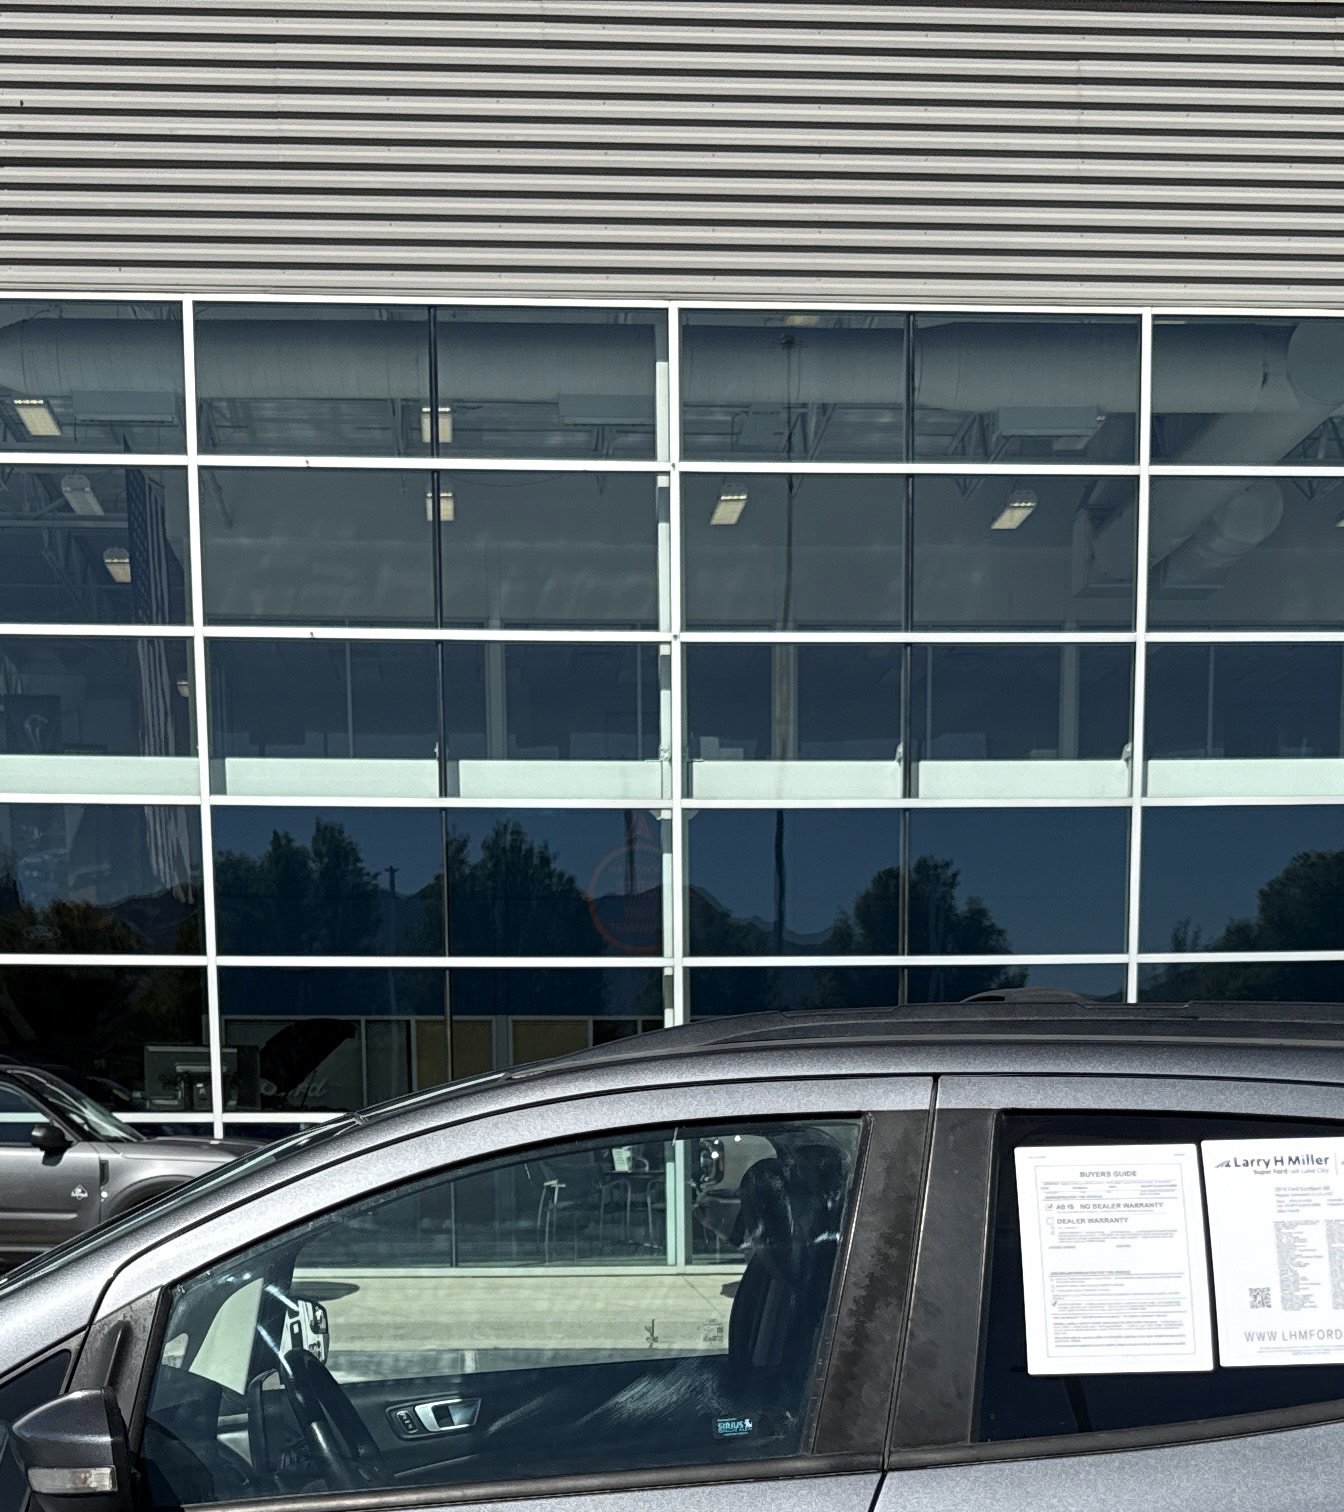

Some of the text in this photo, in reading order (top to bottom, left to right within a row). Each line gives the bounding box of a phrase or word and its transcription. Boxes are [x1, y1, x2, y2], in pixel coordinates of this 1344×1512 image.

[1233, 1154, 1330, 1168] Larry H Miller
[1057, 1217, 1086, 1225] DEALER
